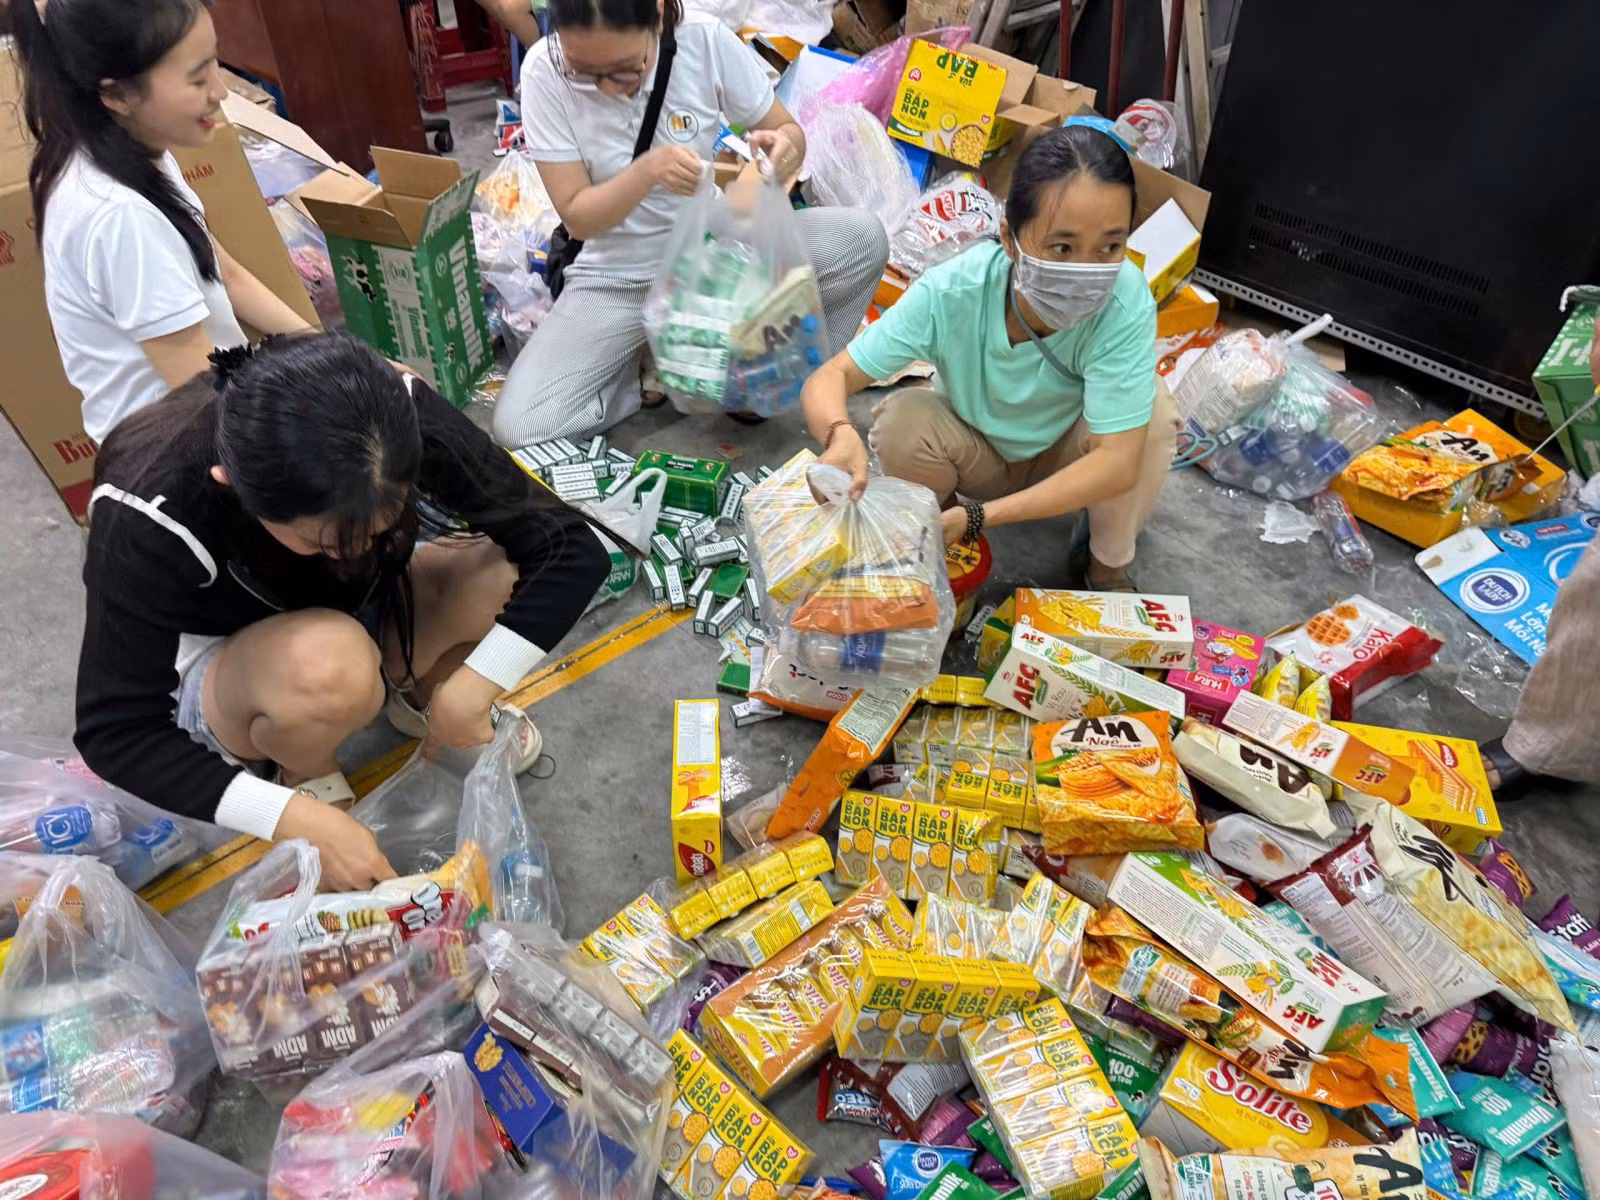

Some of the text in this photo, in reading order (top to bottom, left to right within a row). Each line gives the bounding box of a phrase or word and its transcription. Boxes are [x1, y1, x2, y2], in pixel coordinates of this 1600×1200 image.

[901, 102, 927, 120] NON
[450, 235, 485, 375] Vinamilk
[1441, 432, 1490, 462] An
[1478, 583, 1503, 602] LADY
[1483, 577, 1513, 600] DUTCH
[1140, 599, 1178, 633] AFC
[1020, 633, 1045, 644] AFC
[1503, 618, 1535, 643] Mỗi
[1352, 627, 1394, 660] Karo
[1160, 652, 1187, 664] AFC
[1013, 662, 1040, 711] AFC
[1193, 674, 1223, 690] HURA
[1060, 717, 1142, 743] An
[1354, 768, 1388, 785] AFC
[843, 815, 869, 828] NON
[879, 821, 907, 835] NON
[918, 828, 947, 841] NON
[869, 997, 902, 1008] NON
[912, 1001, 944, 1012] NON
[953, 1005, 985, 1016] NON
[1282, 1004, 1325, 1030] AFC
[273, 1034, 308, 1057] ADM
[321, 1025, 357, 1048] ADM
[687, 1087, 714, 1117] NON
[1205, 1060, 1312, 1134] Solite
[717, 1119, 745, 1149] NON
[1495, 1104, 1555, 1147] Vinamilk
[751, 1152, 782, 1183] NON
